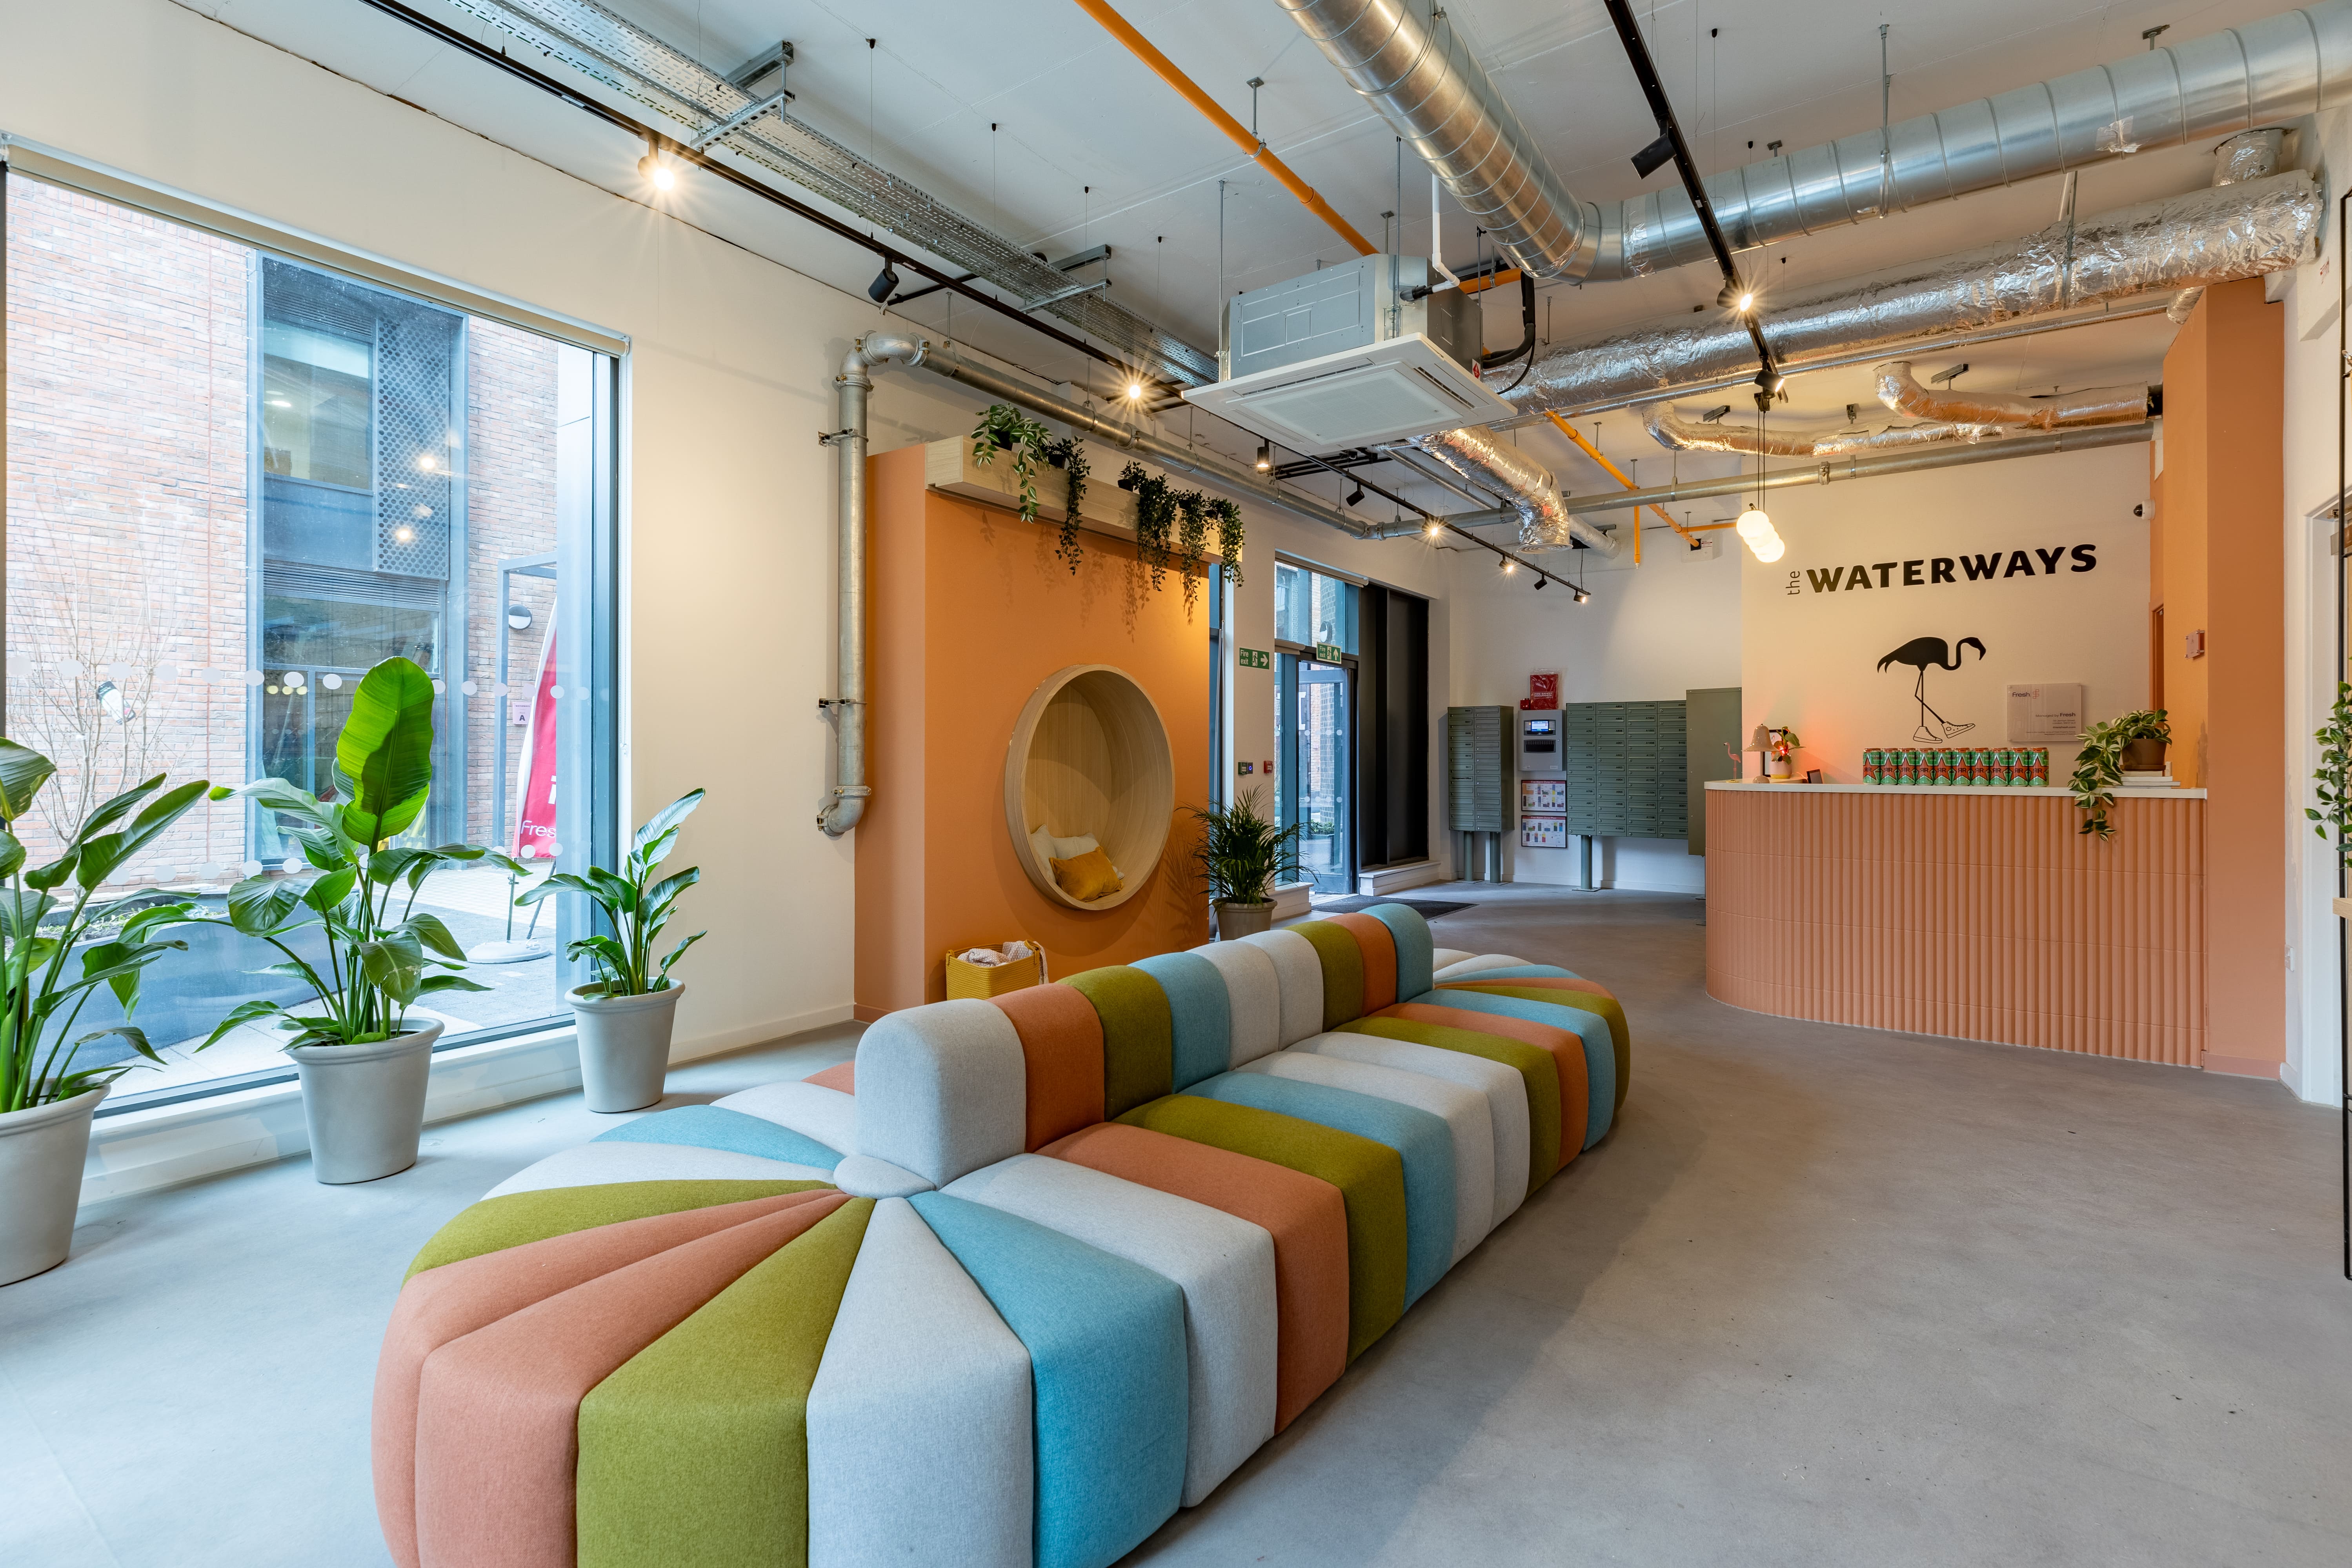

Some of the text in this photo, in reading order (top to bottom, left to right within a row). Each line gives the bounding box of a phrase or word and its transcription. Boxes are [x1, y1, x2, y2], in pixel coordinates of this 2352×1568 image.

[1785, 544, 2097, 595] the WATERWAYS
[1240, 649, 1249, 658] Fire
[520, 820, 557, 838] Fres
